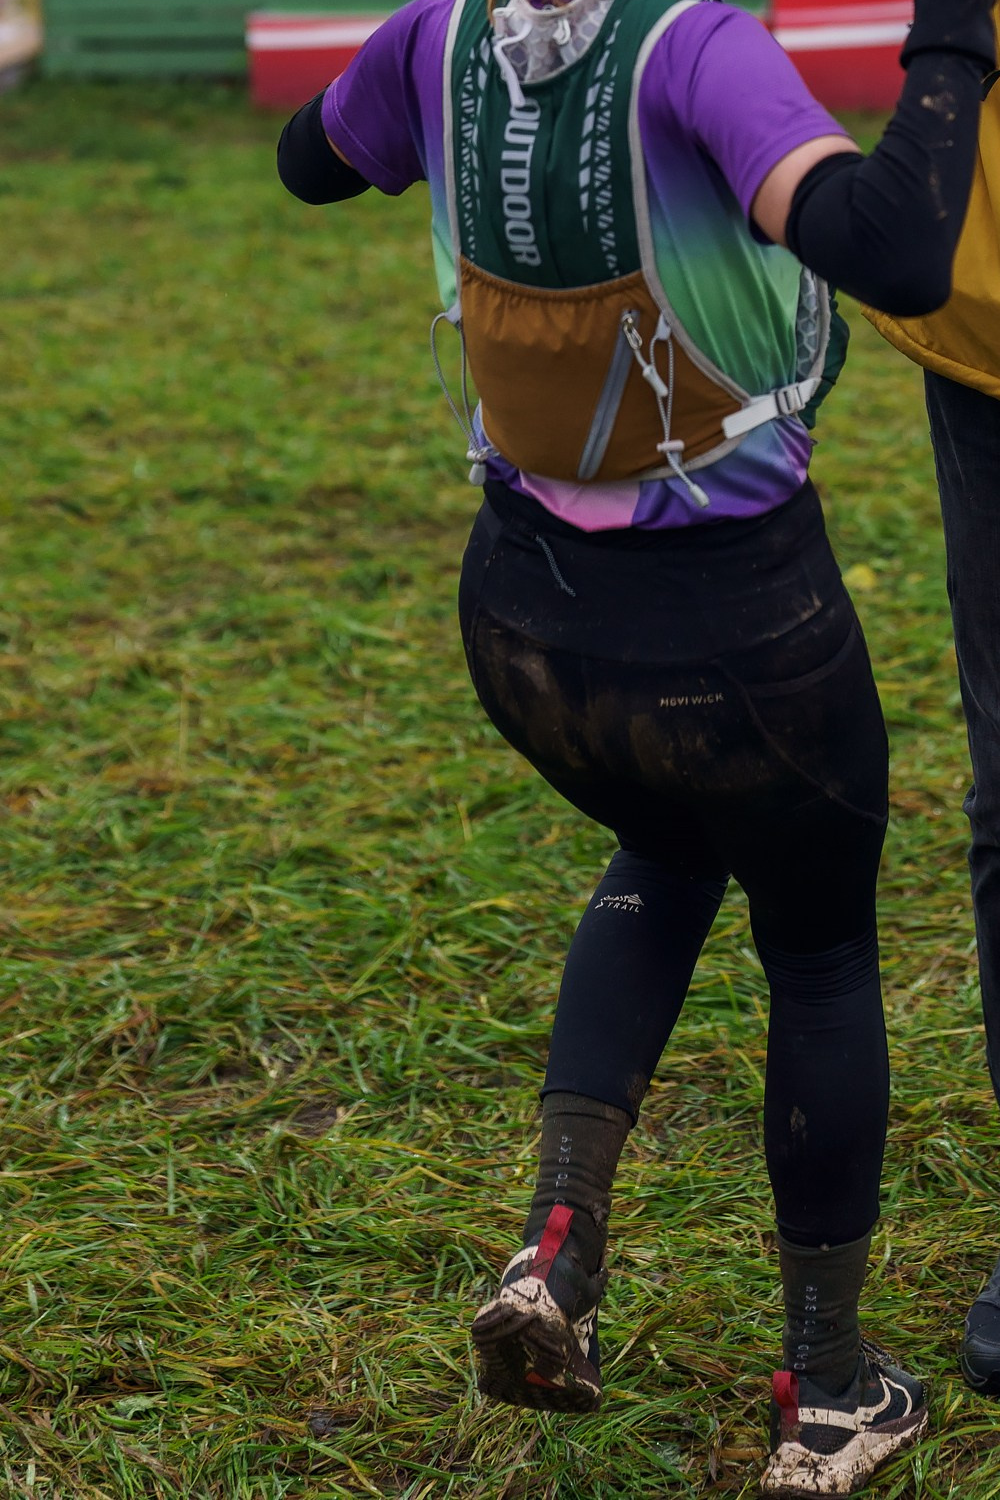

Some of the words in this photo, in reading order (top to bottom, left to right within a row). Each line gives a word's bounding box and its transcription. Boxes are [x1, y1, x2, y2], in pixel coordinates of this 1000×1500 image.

[501, 97, 540, 268] OUTDOOR
[607, 901, 640, 913] TRAIL
[557, 1135, 573, 1165] SKY
[804, 1284, 818, 1312] SKY
